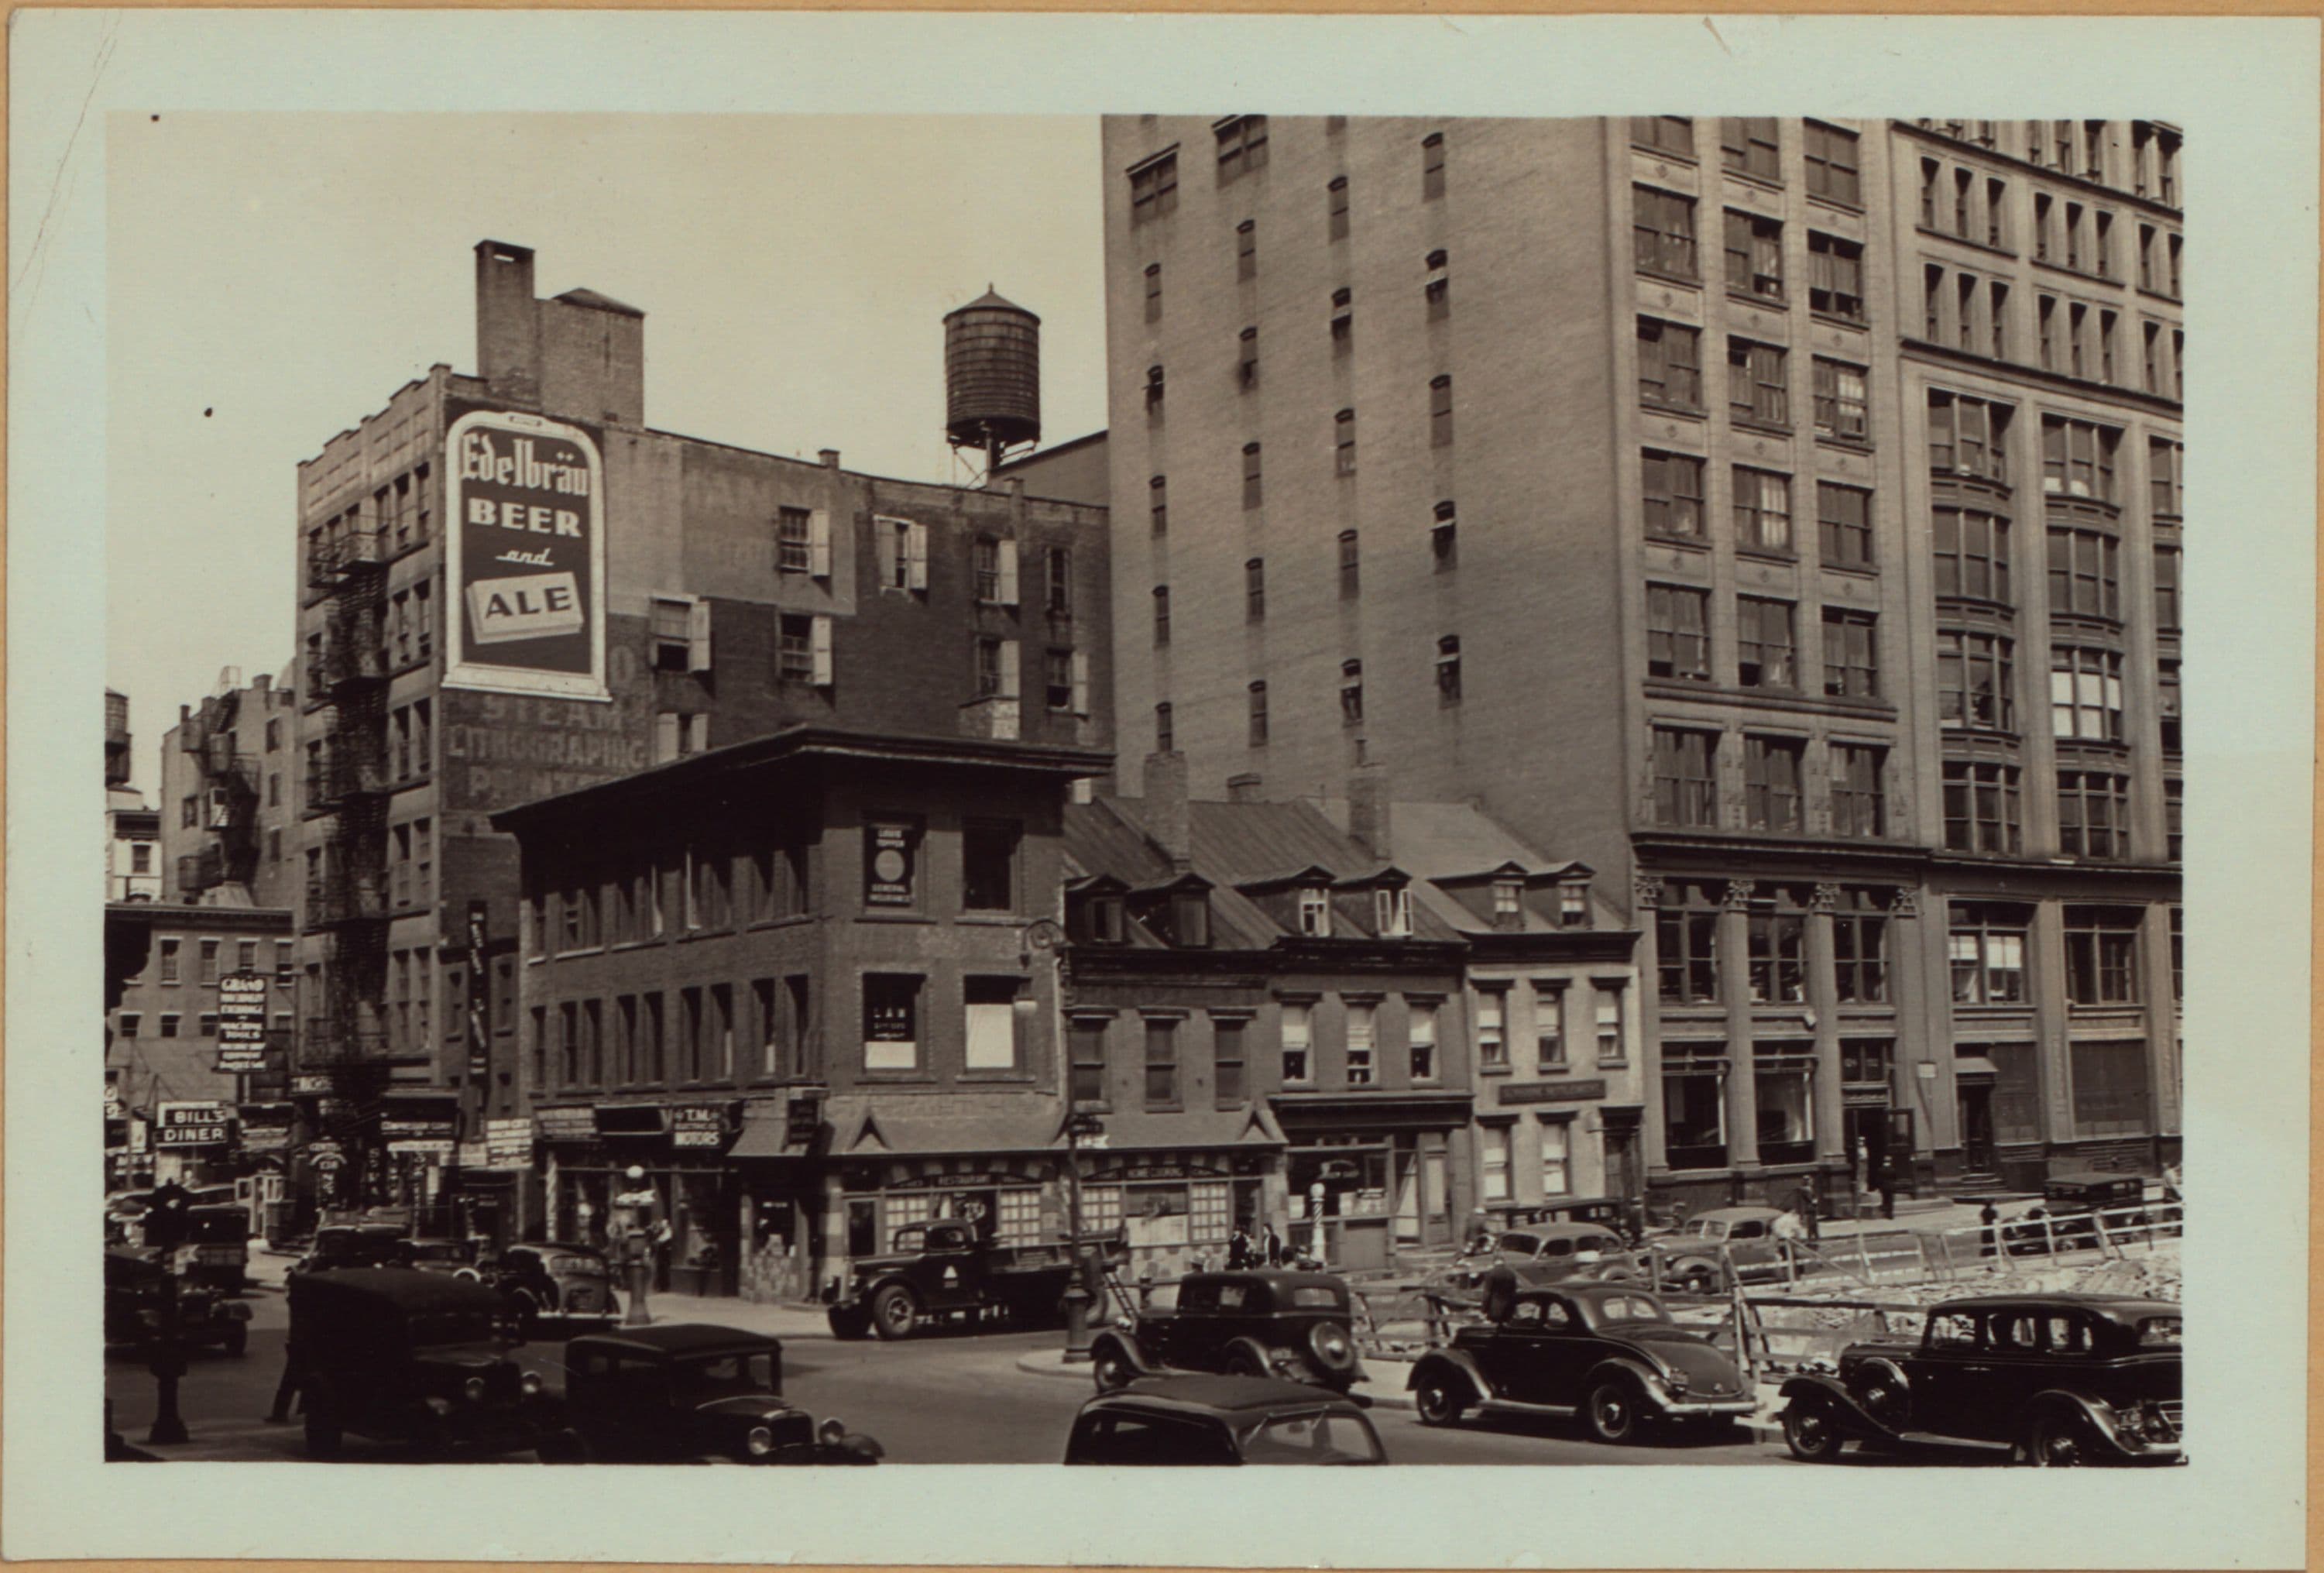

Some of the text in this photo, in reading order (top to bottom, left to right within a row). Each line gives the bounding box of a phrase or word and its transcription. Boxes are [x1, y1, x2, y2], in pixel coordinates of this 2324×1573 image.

[461, 432, 589, 496] Edelbräu
[468, 496, 582, 537] BEER
[496, 547, 554, 566] and
[486, 586, 572, 619] ALE
[480, 695, 623, 731] STEAM
[221, 978, 265, 992] GRAND
[174, 1109, 226, 1124] BILL'S
[163, 1127, 225, 1142] DINER
[674, 1132, 720, 1145] MOTORS
